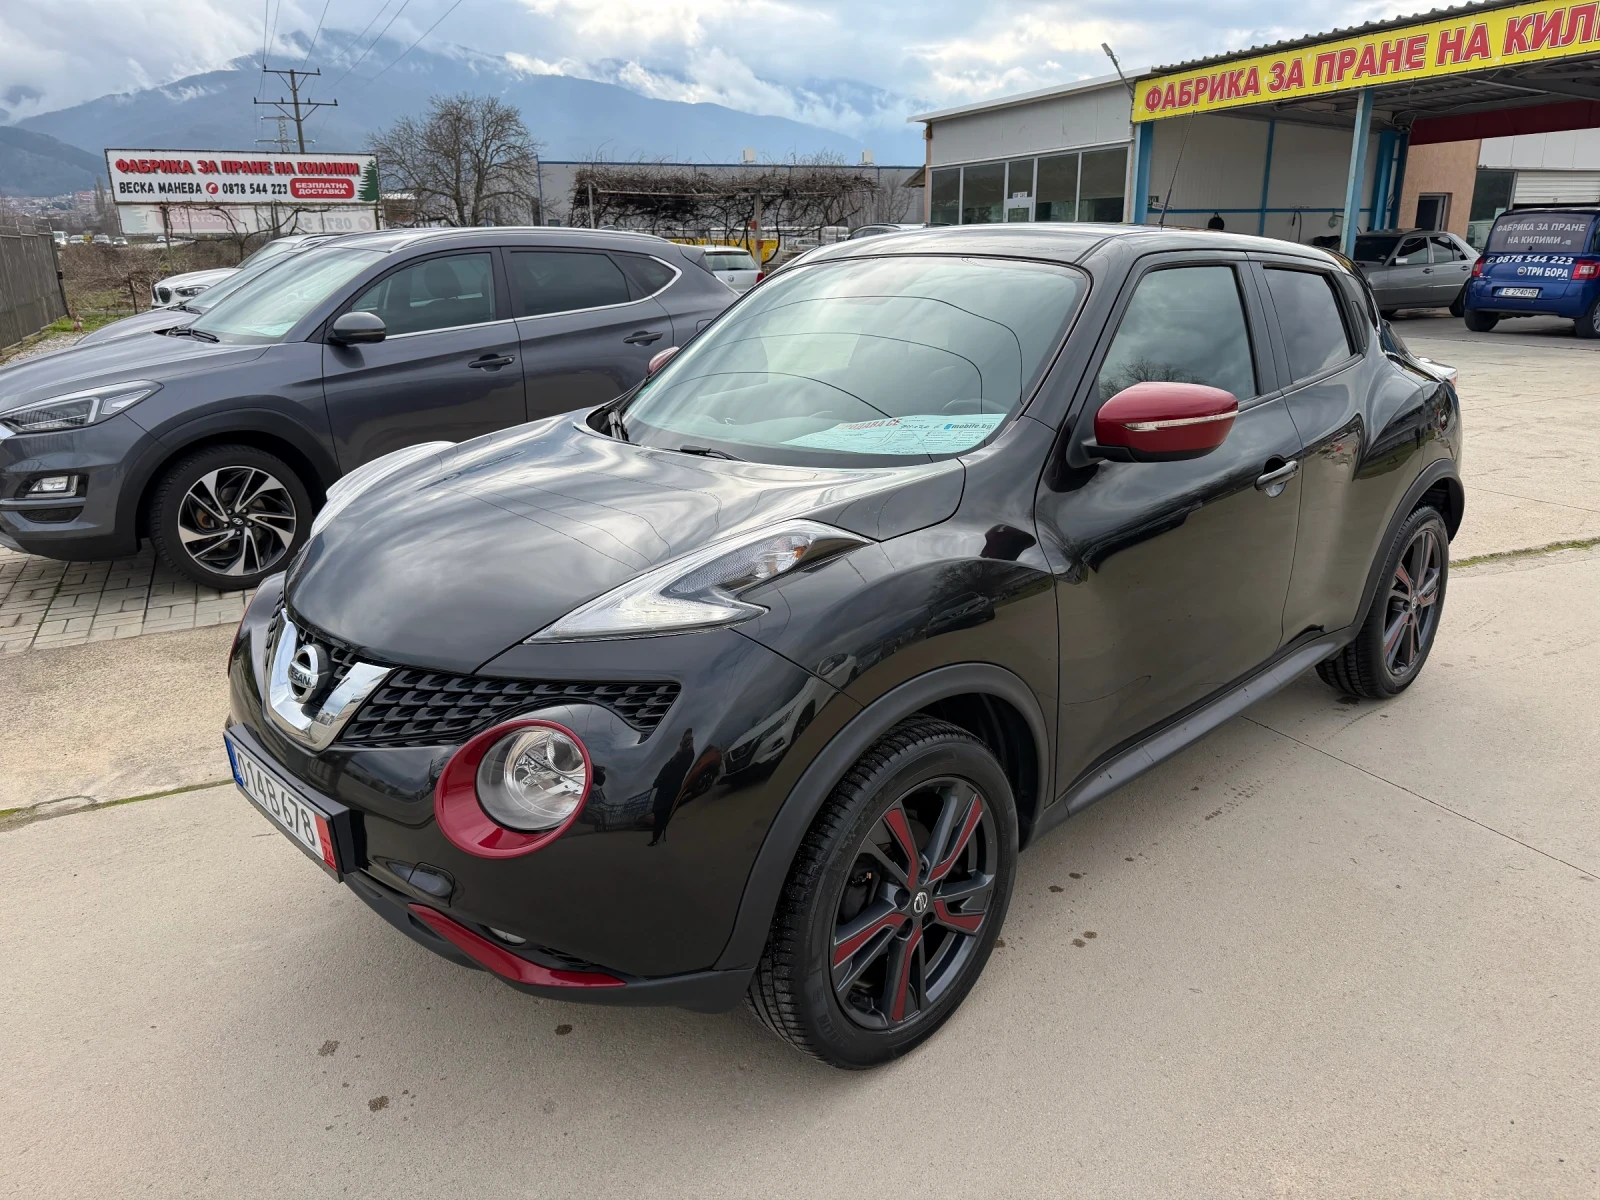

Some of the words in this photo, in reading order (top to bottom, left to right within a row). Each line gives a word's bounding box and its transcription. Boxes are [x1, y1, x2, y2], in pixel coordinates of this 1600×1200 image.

[1144, 66, 1261, 113] ФАБРИКА
[1268, 58, 1305, 93] ЗА
[1312, 34, 1429, 86] ПРАНЕ
[1435, 23, 1492, 67] НА
[1502, 2, 1600, 56] КИЛ
[115, 159, 195, 174] ФАБРИКА
[197, 160, 220, 174] ЗА
[221, 160, 273, 175] ПРАНЕ
[274, 161, 297, 175] НА
[297, 162, 361, 176] КИЛИМИ
[119, 182, 155, 194] ВЕСКА
[158, 182, 203, 194] МАНЕВА
[222, 183, 246, 194] 0878
[249, 183, 268, 195] 544
[271, 183, 288, 195] 223
[1496, 223, 1534, 232] ФАБРИКА
[1536, 223, 1549, 231] ЗА
[1550, 223, 1586, 232] ПРАНЕ
[1507, 236, 1519, 244] НА
[1520, 236, 1562, 244] КИЛИМИ
[1496, 255, 1522, 263] 0878
[1524, 255, 1548, 263] 544
[1549, 256, 1574, 265] 223
[1527, 266, 1544, 276] ТРИ
[1544, 267, 1569, 278] БОРА
